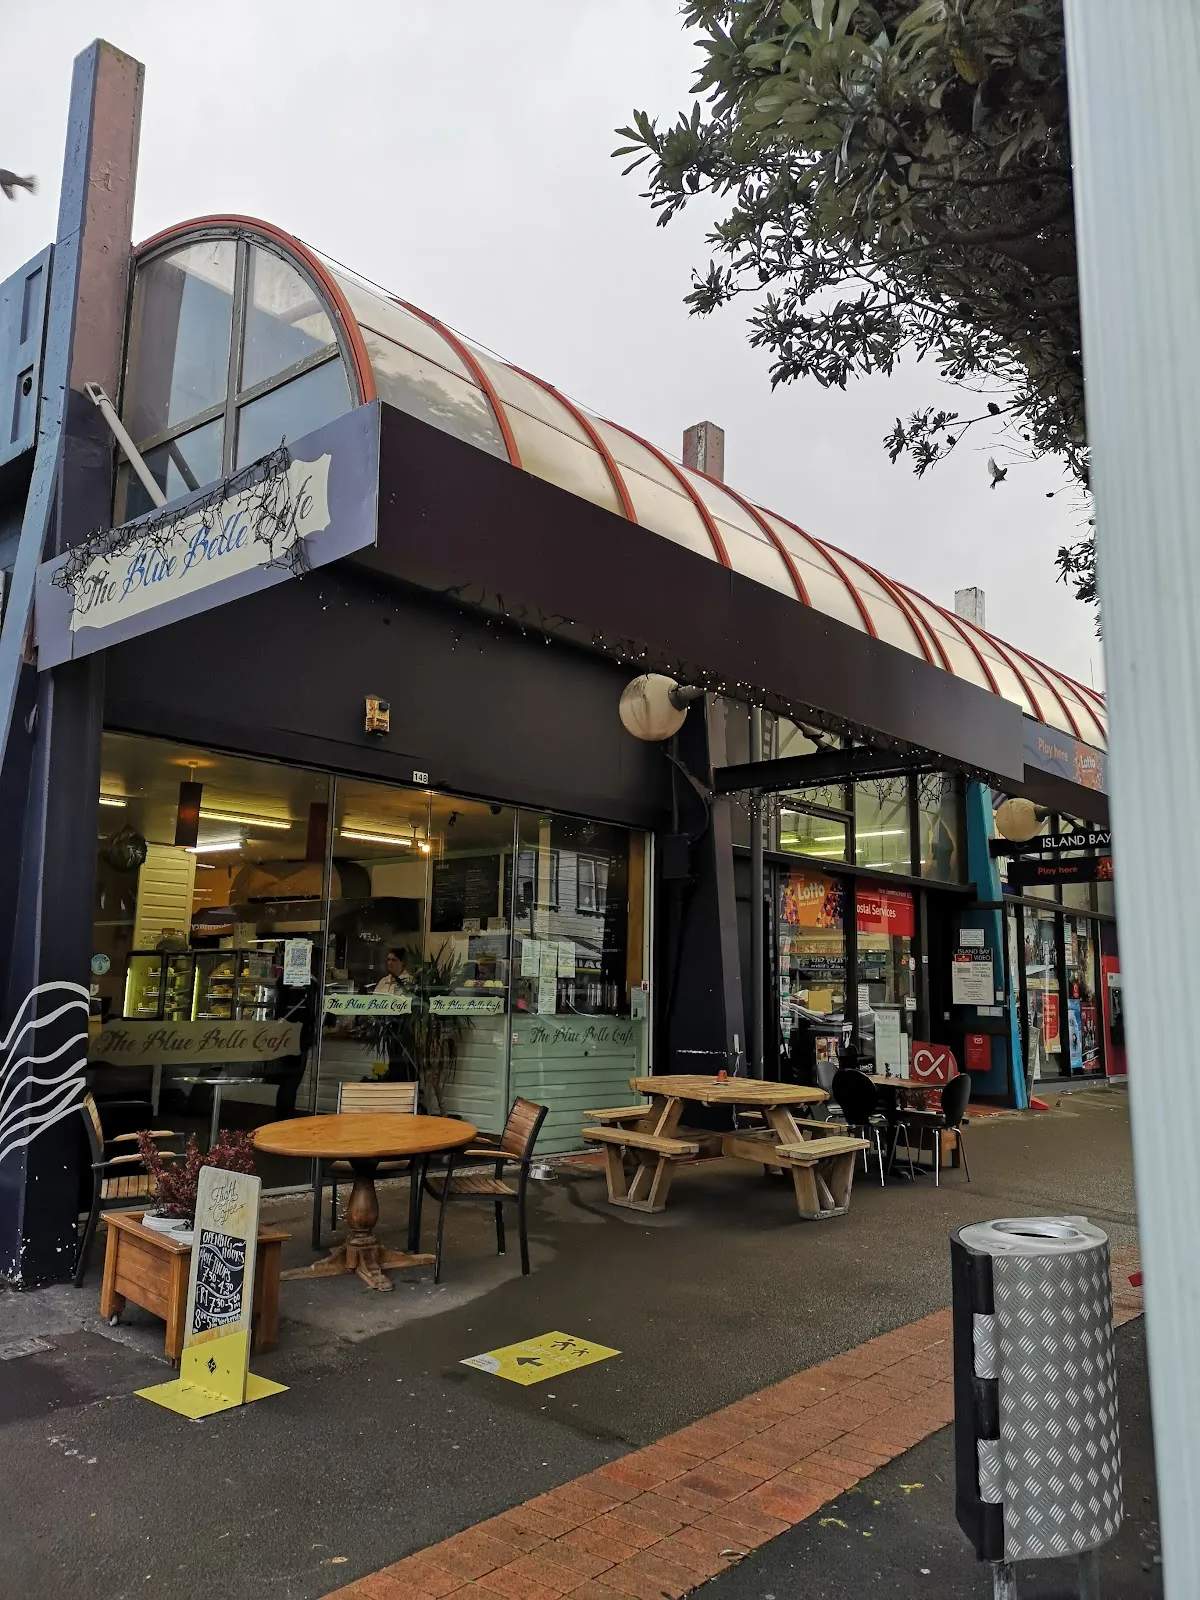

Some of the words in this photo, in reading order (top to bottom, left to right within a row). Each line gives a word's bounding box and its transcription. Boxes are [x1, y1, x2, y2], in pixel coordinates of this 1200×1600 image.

[84, 569, 118, 615] The
[119, 543, 178, 603] Blue
[179, 511, 248, 579] Belle
[1080, 755, 1097, 770] Lotto
[414, 772, 429, 784] 148
[1042, 834, 1086, 849] ISLAND
[1088, 832, 1112, 845] BAY
[1038, 865, 1056, 876] Play
[797, 882, 825, 900] Lotto
[856, 903, 872, 916] ostal
[872, 904, 897, 919] Services
[327, 998, 343, 1009] The
[344, 998, 367, 1009] Blue
[368, 998, 389, 1009] Belle
[96, 1030, 137, 1054] The
[142, 1027, 193, 1054] Blue
[197, 1027, 248, 1053] Belle
[530, 1026, 552, 1044] The
[552, 1026, 580, 1044] Blue
[581, 1025, 610, 1044] Belle
